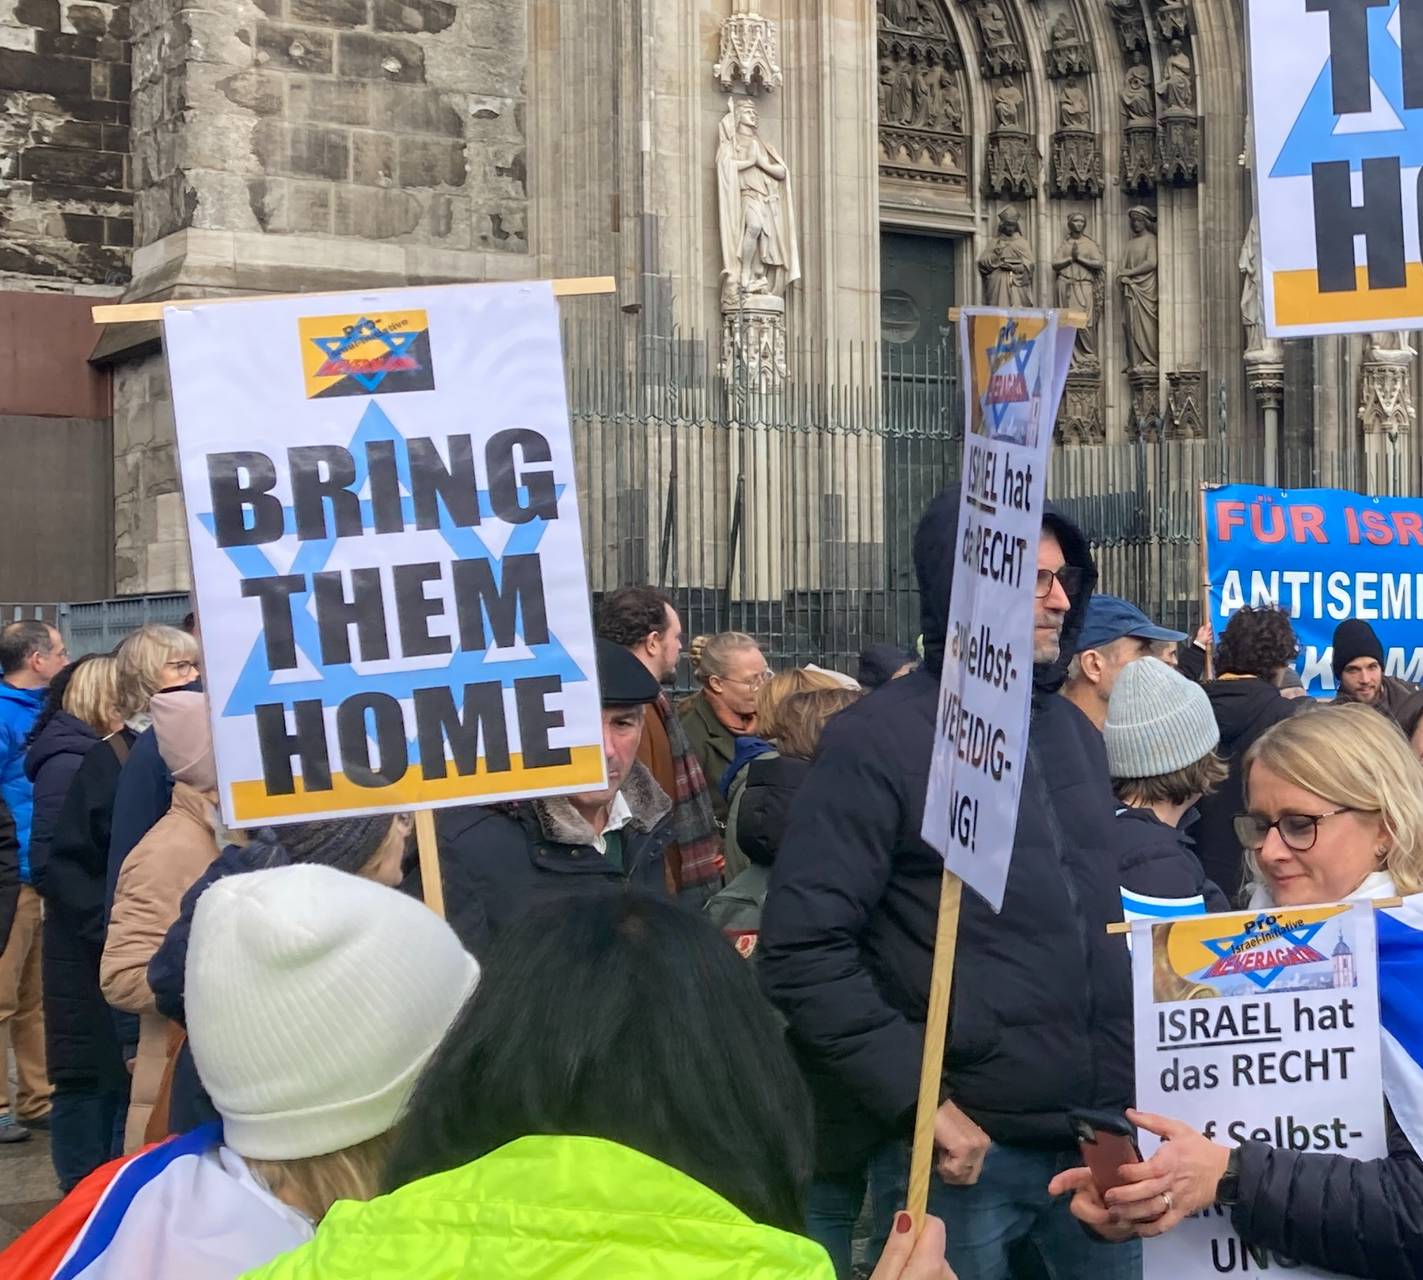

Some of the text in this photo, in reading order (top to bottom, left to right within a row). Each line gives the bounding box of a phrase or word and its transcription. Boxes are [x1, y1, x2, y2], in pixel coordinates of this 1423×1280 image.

[207, 428, 559, 548] BRING
[968, 446, 1033, 512] ISEL hat
[1216, 495, 1328, 546] FÜR
[241, 553, 549, 671] THEM
[967, 624, 1017, 692] elbst-
[254, 675, 571, 796] HOME
[943, 688, 1011, 781] VEEIDIG-
[949, 790, 978, 854] NG!
[1231, 918, 1305, 954] Israel-Initiative
[1244, 914, 1283, 935] Pro-
[1157, 997, 1354, 1043] ISRAEL hat
[1160, 1047, 1355, 1092] das RECHT
[1228, 1116, 1363, 1150] Selbst-
